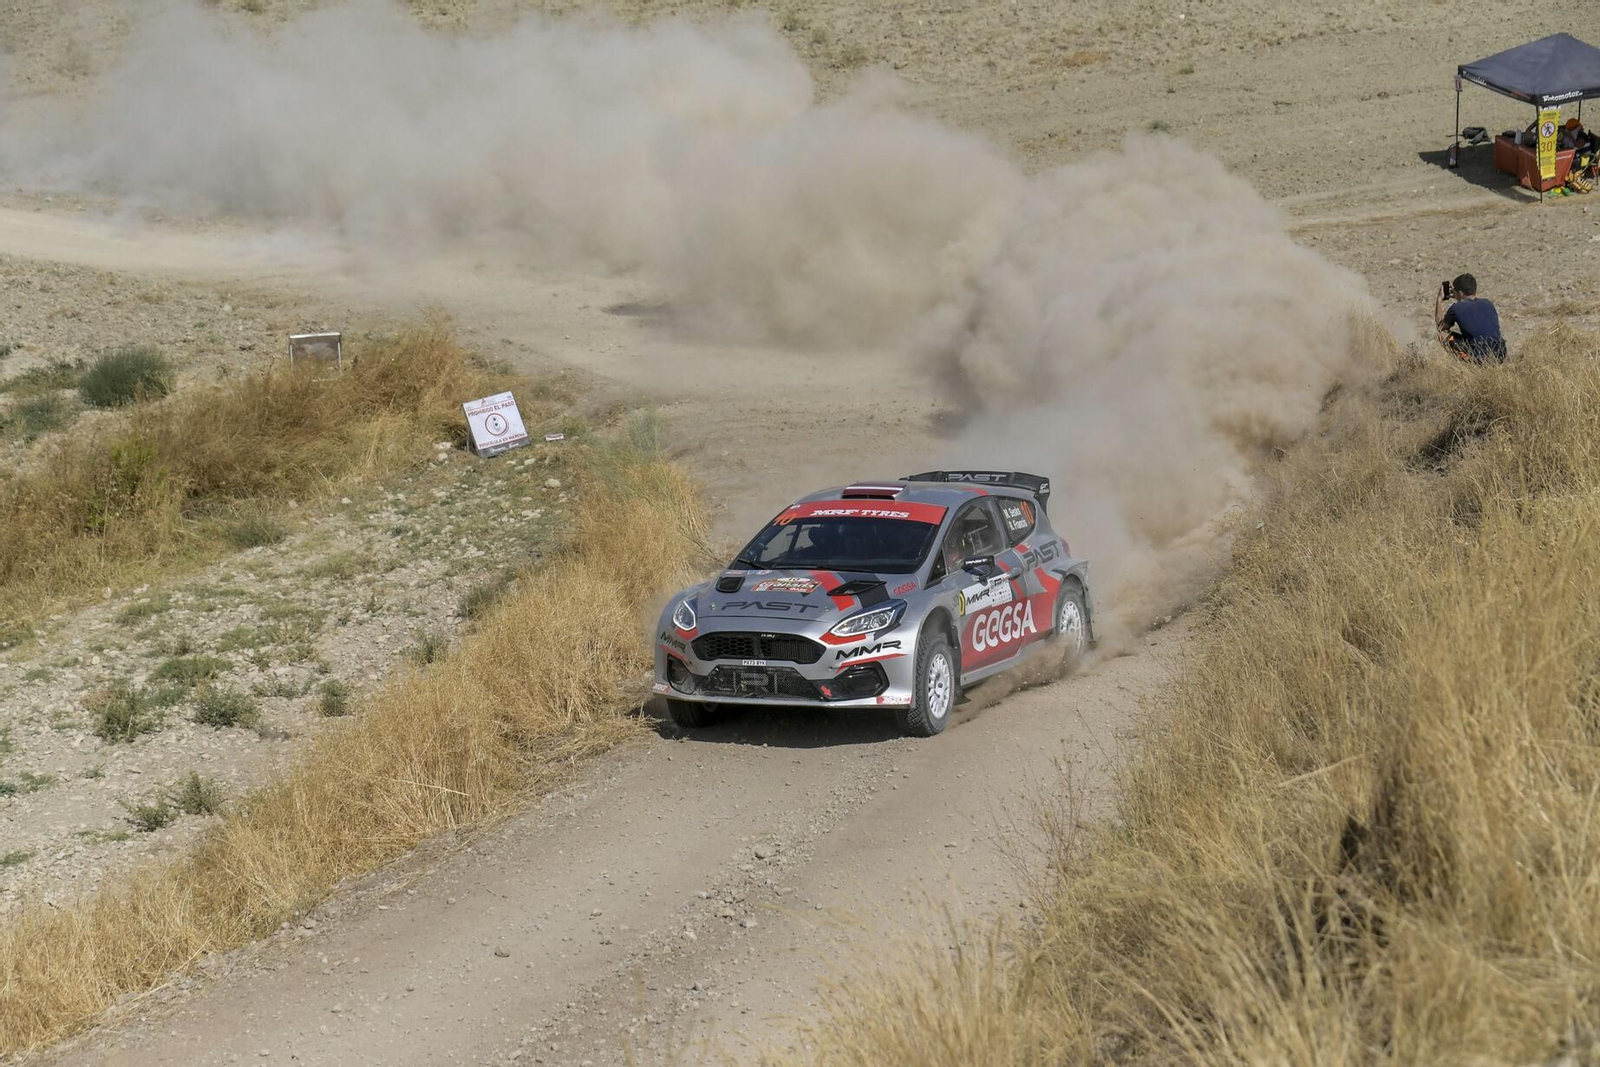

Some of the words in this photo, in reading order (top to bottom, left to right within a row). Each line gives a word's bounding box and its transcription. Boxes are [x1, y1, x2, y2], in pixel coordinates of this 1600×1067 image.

[467, 407, 494, 417] PROHIBIDO
[501, 400, 515, 410] PASO
[948, 473, 1007, 482] PAST
[772, 513, 797, 526] 10
[810, 509, 860, 517] MRF
[861, 509, 910, 519] TYRES
[1022, 540, 1060, 572] PAST
[965, 589, 990, 606] MMR
[720, 601, 820, 614] PAST
[660, 631, 687, 654] MMR
[835, 640, 903, 660] MMR
